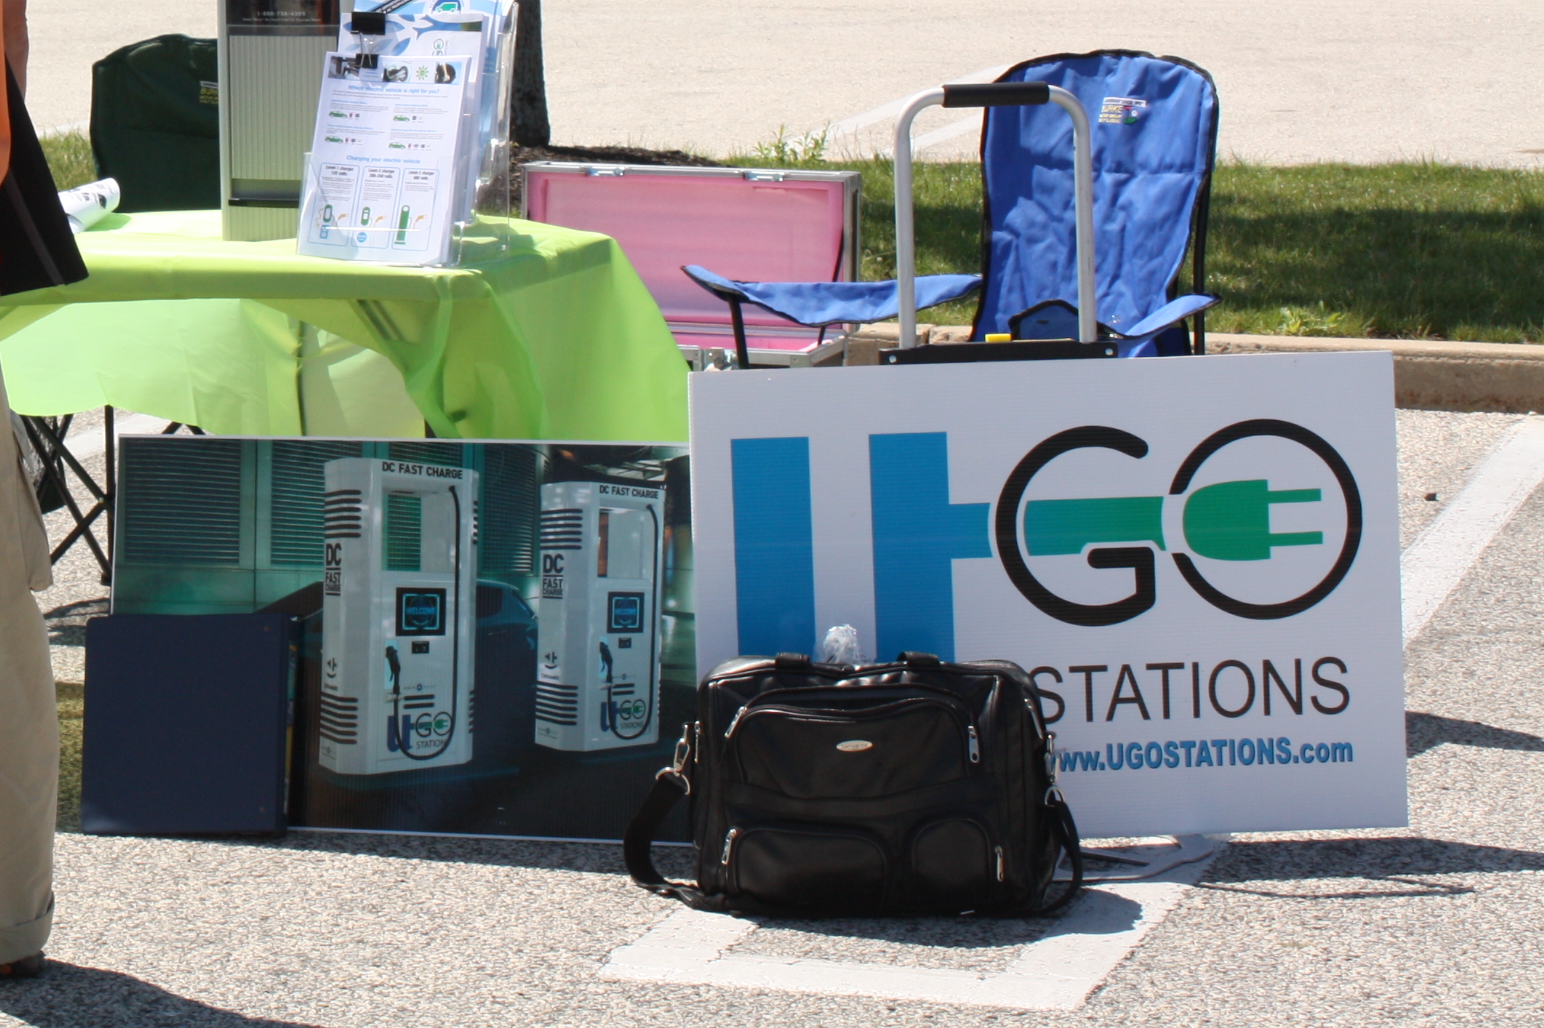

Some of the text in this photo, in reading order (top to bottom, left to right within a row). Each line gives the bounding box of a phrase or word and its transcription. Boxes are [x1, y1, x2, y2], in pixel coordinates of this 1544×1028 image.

[382, 461, 463, 480] DC FAST CHARGE
[599, 484, 659, 499] DC FAST CHARGE
[325, 543, 342, 567] DC
[543, 554, 564, 574] DC
[325, 572, 341, 583] FAST
[542, 578, 563, 590] FAST
[1029, 656, 1350, 724] STATIONS
